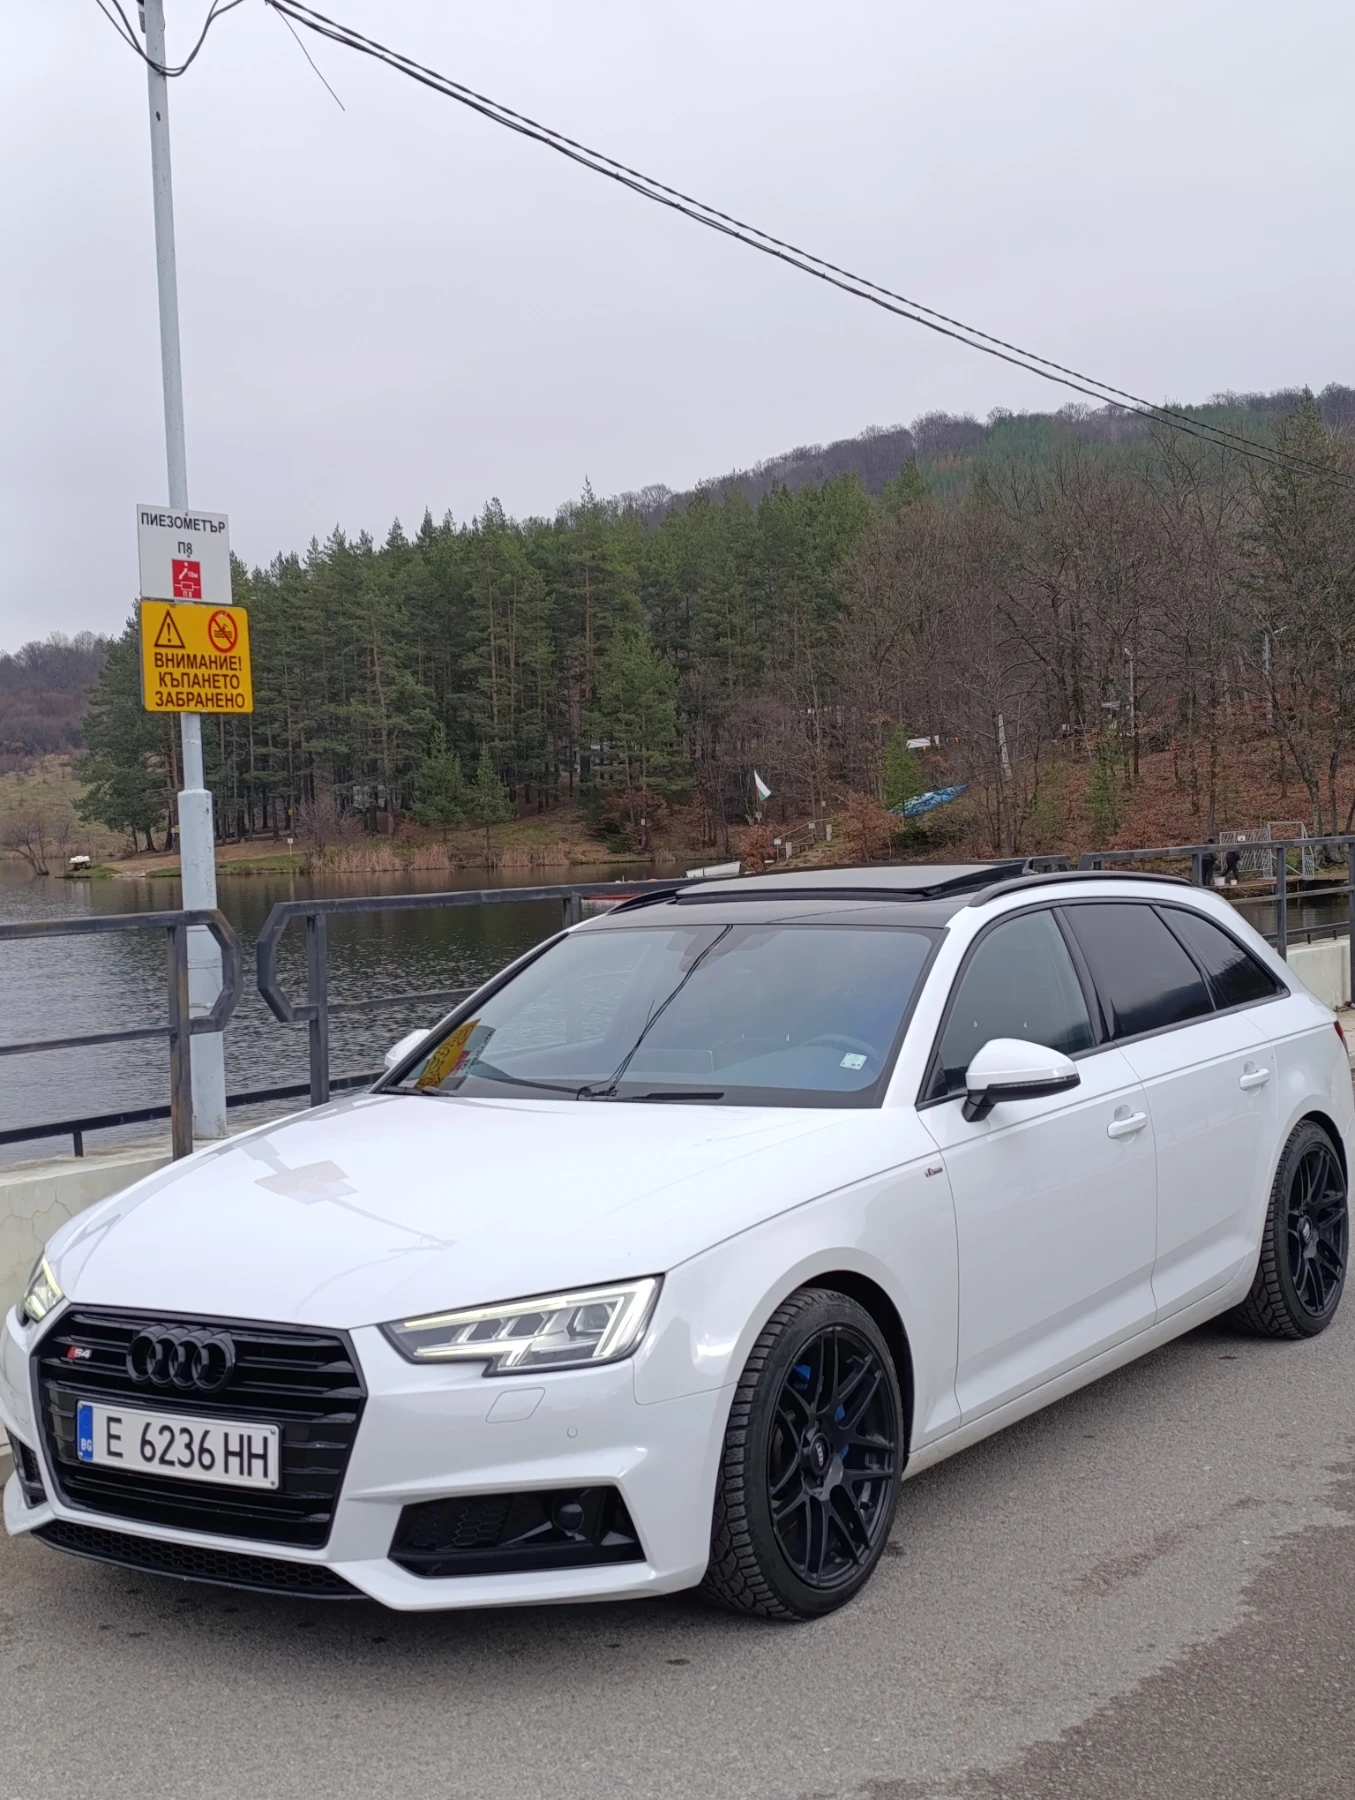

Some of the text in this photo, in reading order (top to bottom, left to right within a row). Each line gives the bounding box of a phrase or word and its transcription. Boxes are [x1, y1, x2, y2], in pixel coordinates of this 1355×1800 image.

[141, 512, 226, 534] ПИЕЗОМЕТЪР
[178, 541, 193, 555] П8
[154, 652, 242, 671] ВНИМАНИЕ!
[158, 672, 240, 690] КЪПАНЕТО
[155, 691, 245, 709] ЗАБРАНЕНО
[80, 1438, 92, 1452] BG
[106, 1416, 269, 1479] E 6236 HH
